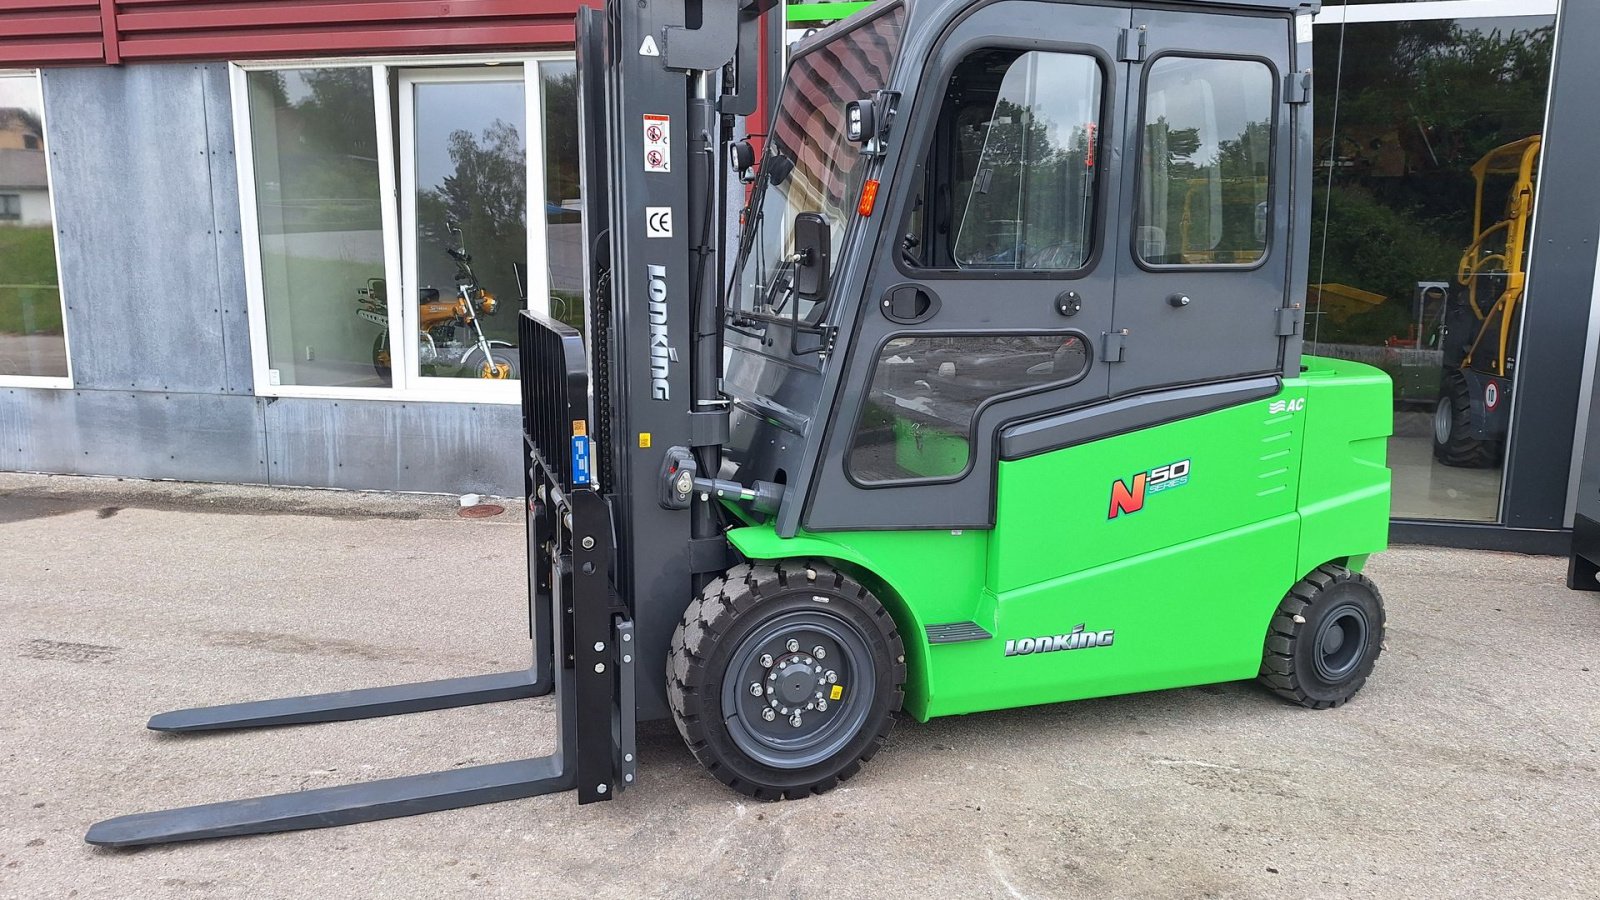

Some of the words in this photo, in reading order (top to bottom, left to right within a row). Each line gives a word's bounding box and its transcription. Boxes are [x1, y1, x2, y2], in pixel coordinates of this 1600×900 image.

[649, 212, 670, 232] CE
[1488, 388, 1495, 402] 10
[1286, 397, 1305, 412] AC
[1148, 475, 1188, 494] SERIES
